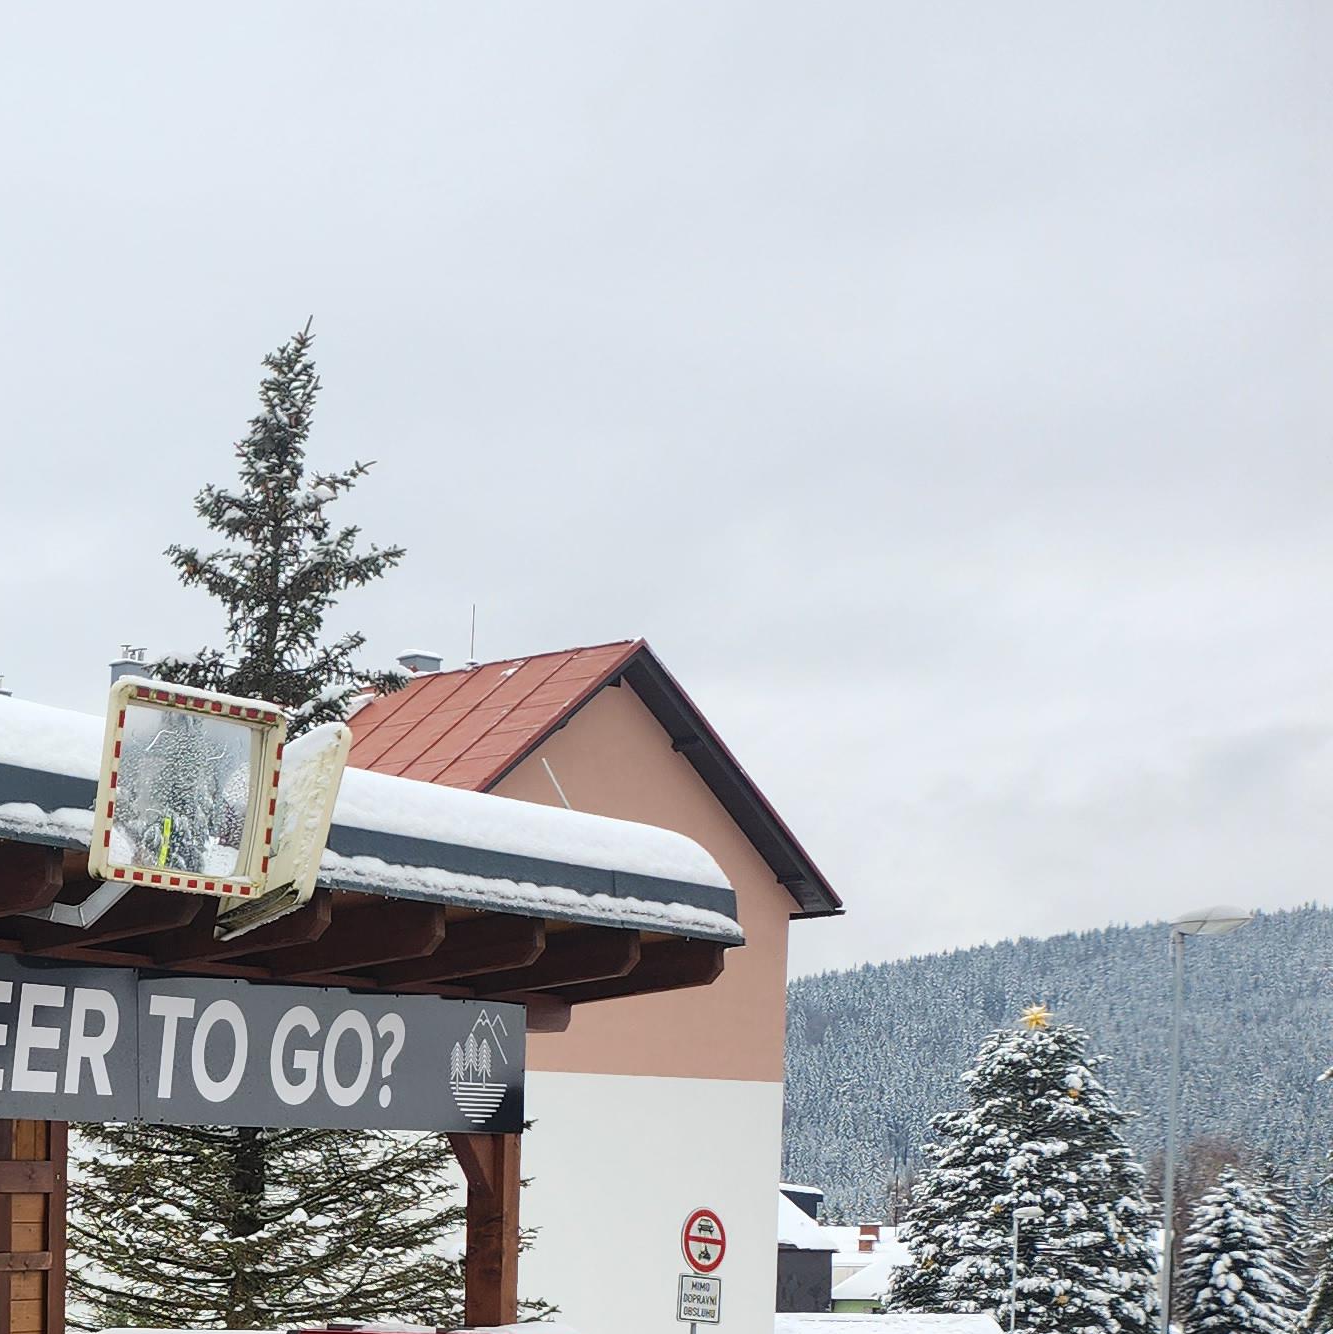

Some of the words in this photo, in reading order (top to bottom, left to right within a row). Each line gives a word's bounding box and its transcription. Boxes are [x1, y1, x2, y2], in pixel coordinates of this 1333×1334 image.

[149, 994, 247, 1102] TO
[269, 1004, 405, 1109] GO?
[691, 1280, 710, 1292] MIMO
[683, 1293, 717, 1306] DOPRAVNÍ
[683, 1307, 716, 1318] OBSLUHU
